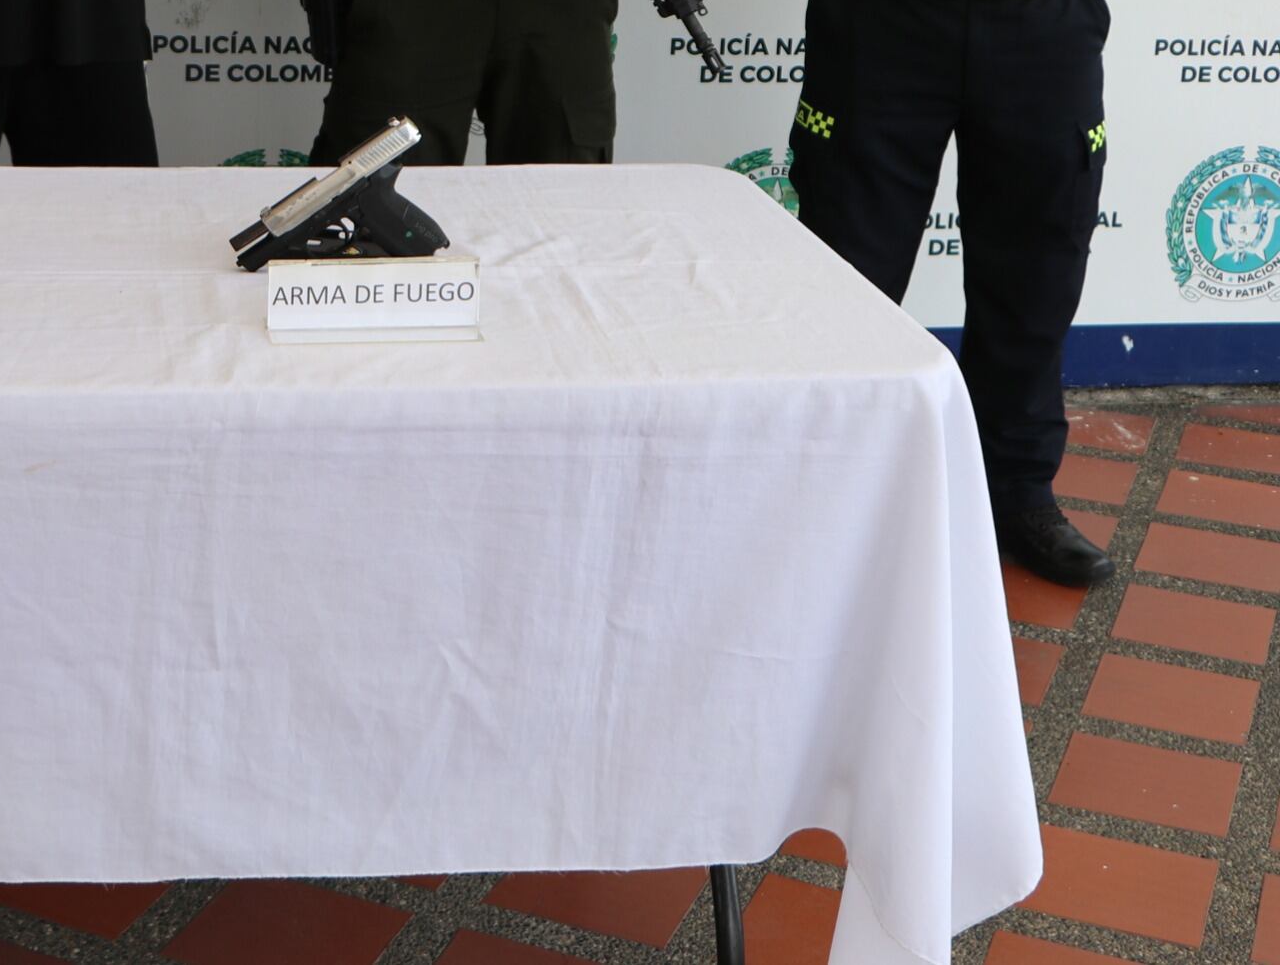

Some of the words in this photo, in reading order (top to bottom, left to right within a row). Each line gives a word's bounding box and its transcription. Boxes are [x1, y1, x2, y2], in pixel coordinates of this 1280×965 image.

[153, 32, 256, 54] POLICÍA
[671, 33, 768, 55] POICÍA
[1155, 35, 1245, 56] POLICÍA
[185, 64, 220, 82] DE
[700, 65, 733, 83] DE
[740, 66, 805, 82] COLO
[1181, 66, 1212, 82] DE
[1218, 66, 1280, 83] COLO
[1243, 164, 1258, 173] DE
[929, 239, 960, 256] DE
[272, 285, 347, 306] ARMA
[355, 285, 386, 304] DE
[394, 281, 475, 304] FUEGO
[1198, 281, 1223, 296] DIOS
[1236, 281, 1274, 297] PATRIA
